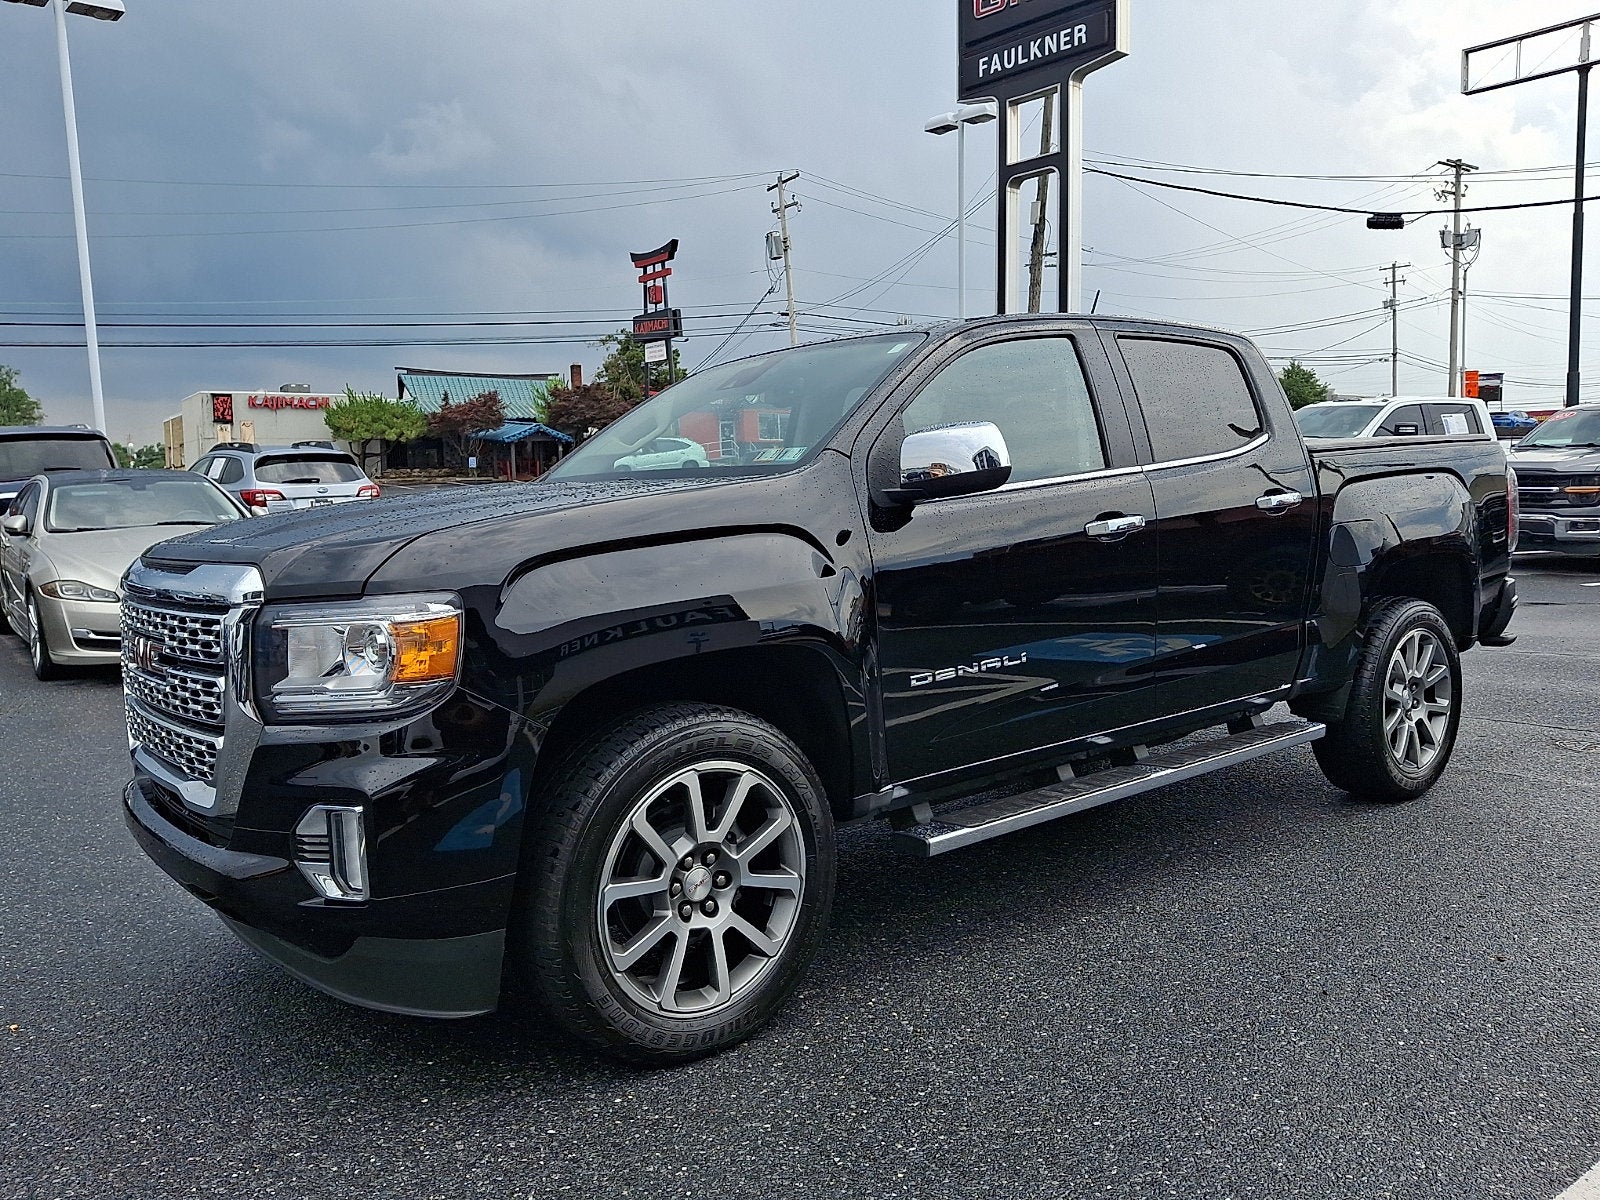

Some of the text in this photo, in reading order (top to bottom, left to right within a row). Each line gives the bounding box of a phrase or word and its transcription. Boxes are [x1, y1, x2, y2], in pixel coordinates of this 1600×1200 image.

[978, 24, 1087, 77] FAULKNER
[248, 395, 331, 410] KAJIMACHI
[910, 651, 1027, 687] DENALI
